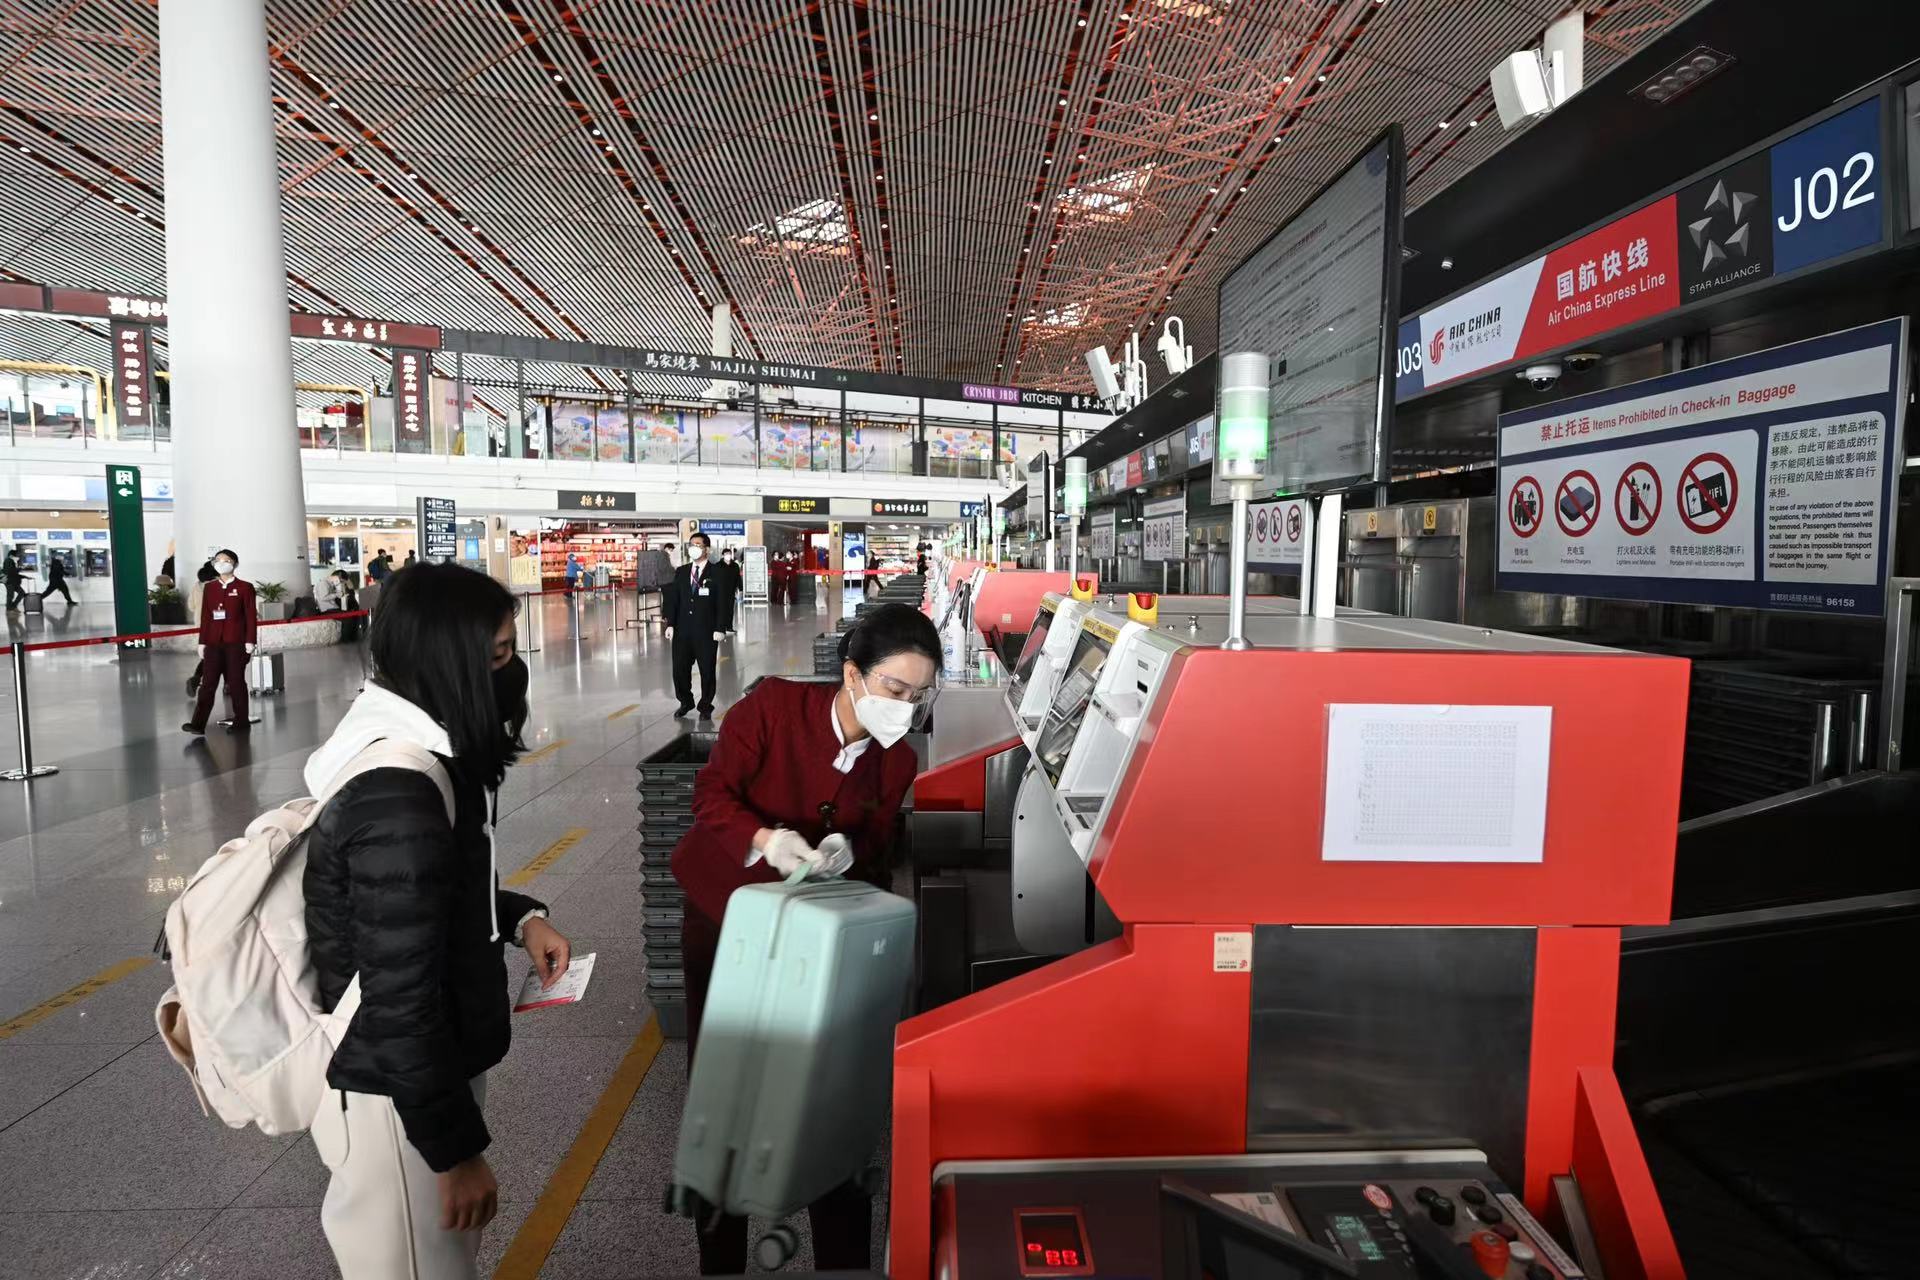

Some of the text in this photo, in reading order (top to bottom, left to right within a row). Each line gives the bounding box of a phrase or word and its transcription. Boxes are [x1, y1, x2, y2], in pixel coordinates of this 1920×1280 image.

[1777, 151, 1875, 232] J02
[1556, 237, 1649, 302] 国航快线
[1689, 263, 1761, 295] STAR ALLIANCE
[1548, 272, 1666, 326] Air China Express Line
[1449, 306, 1502, 341] AIR CHINA
[1395, 342, 1422, 378] J03
[710, 360, 816, 381] MAJIA SHUMAI
[963, 385, 1020, 401] CRYSTAL JADE
[1022, 392, 1063, 406] KITCHEN
[1540, 383, 1796, 441] 禁止托运 Items Prohibited in Check-in Baggage
[1769, 514, 1801, 522] regulations,
[1812, 511, 1843, 520] prohibited
[1802, 522, 1836, 530] Passengers
[1814, 532, 1839, 540] possible
[1811, 542, 1843, 550] impossible
[1843, 542, 1872, 550] transport
[1777, 552, 1803, 560] baggages
[1845, 552, 1861, 560] flight
[1826, 598, 1855, 607] 96158
